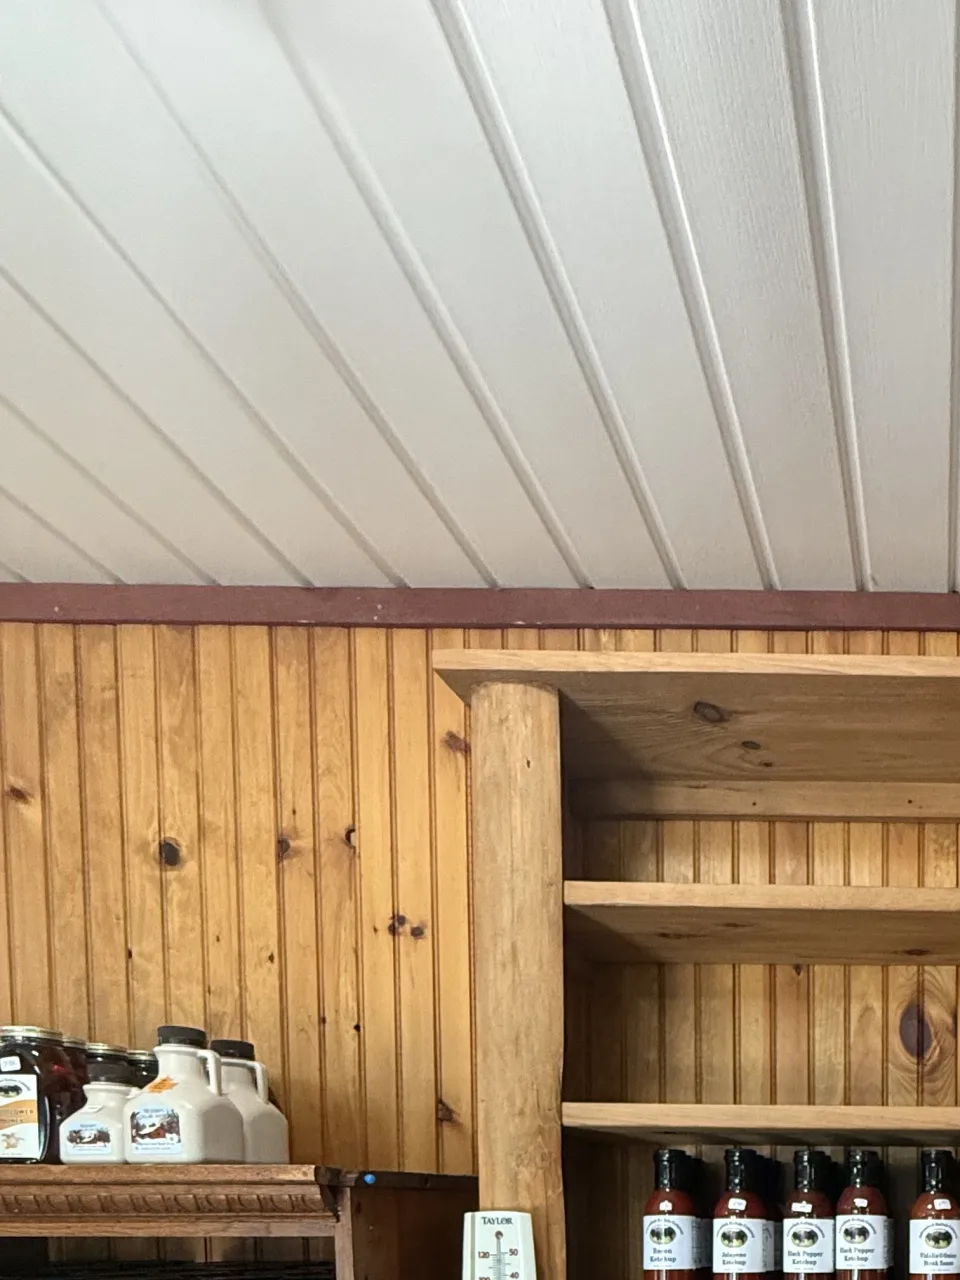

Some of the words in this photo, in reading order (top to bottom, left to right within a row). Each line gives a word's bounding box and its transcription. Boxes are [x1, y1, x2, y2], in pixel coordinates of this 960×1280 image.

[481, 1216, 513, 1225] TAYLOR
[509, 1248, 518, 1256] 50
[509, 1271, 519, 1279] 40
